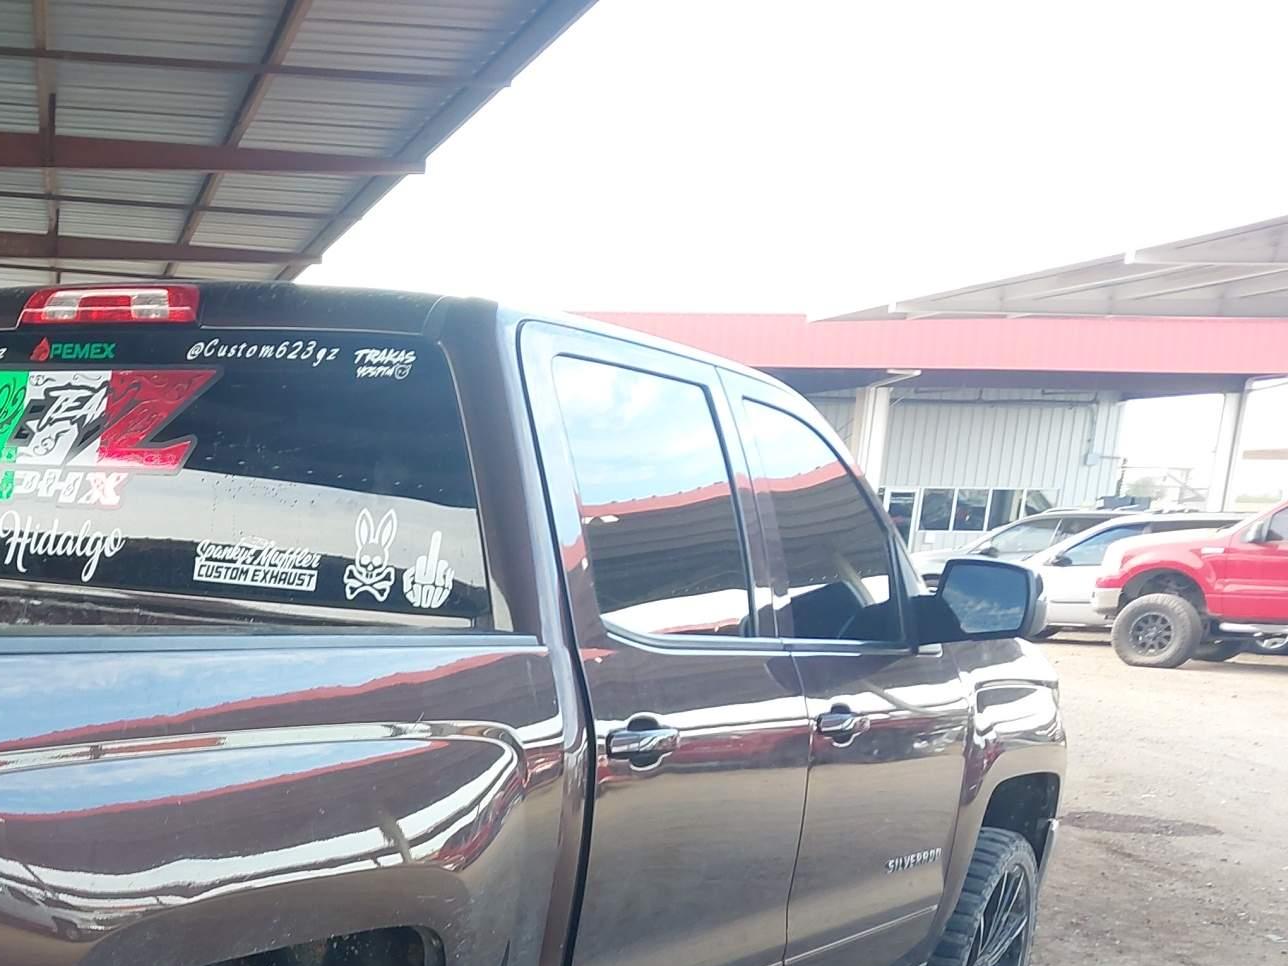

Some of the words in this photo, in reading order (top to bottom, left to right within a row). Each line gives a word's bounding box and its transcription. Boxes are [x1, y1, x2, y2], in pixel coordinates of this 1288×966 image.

[50, 343, 116, 360] PEMEX
[186, 338, 341, 367] @Custom623gz
[354, 348, 417, 365] TRAKAS
[252, 542, 322, 570] Muffler
[197, 564, 250, 582] CUSTOM
[250, 569, 316, 587] EXHAUST
